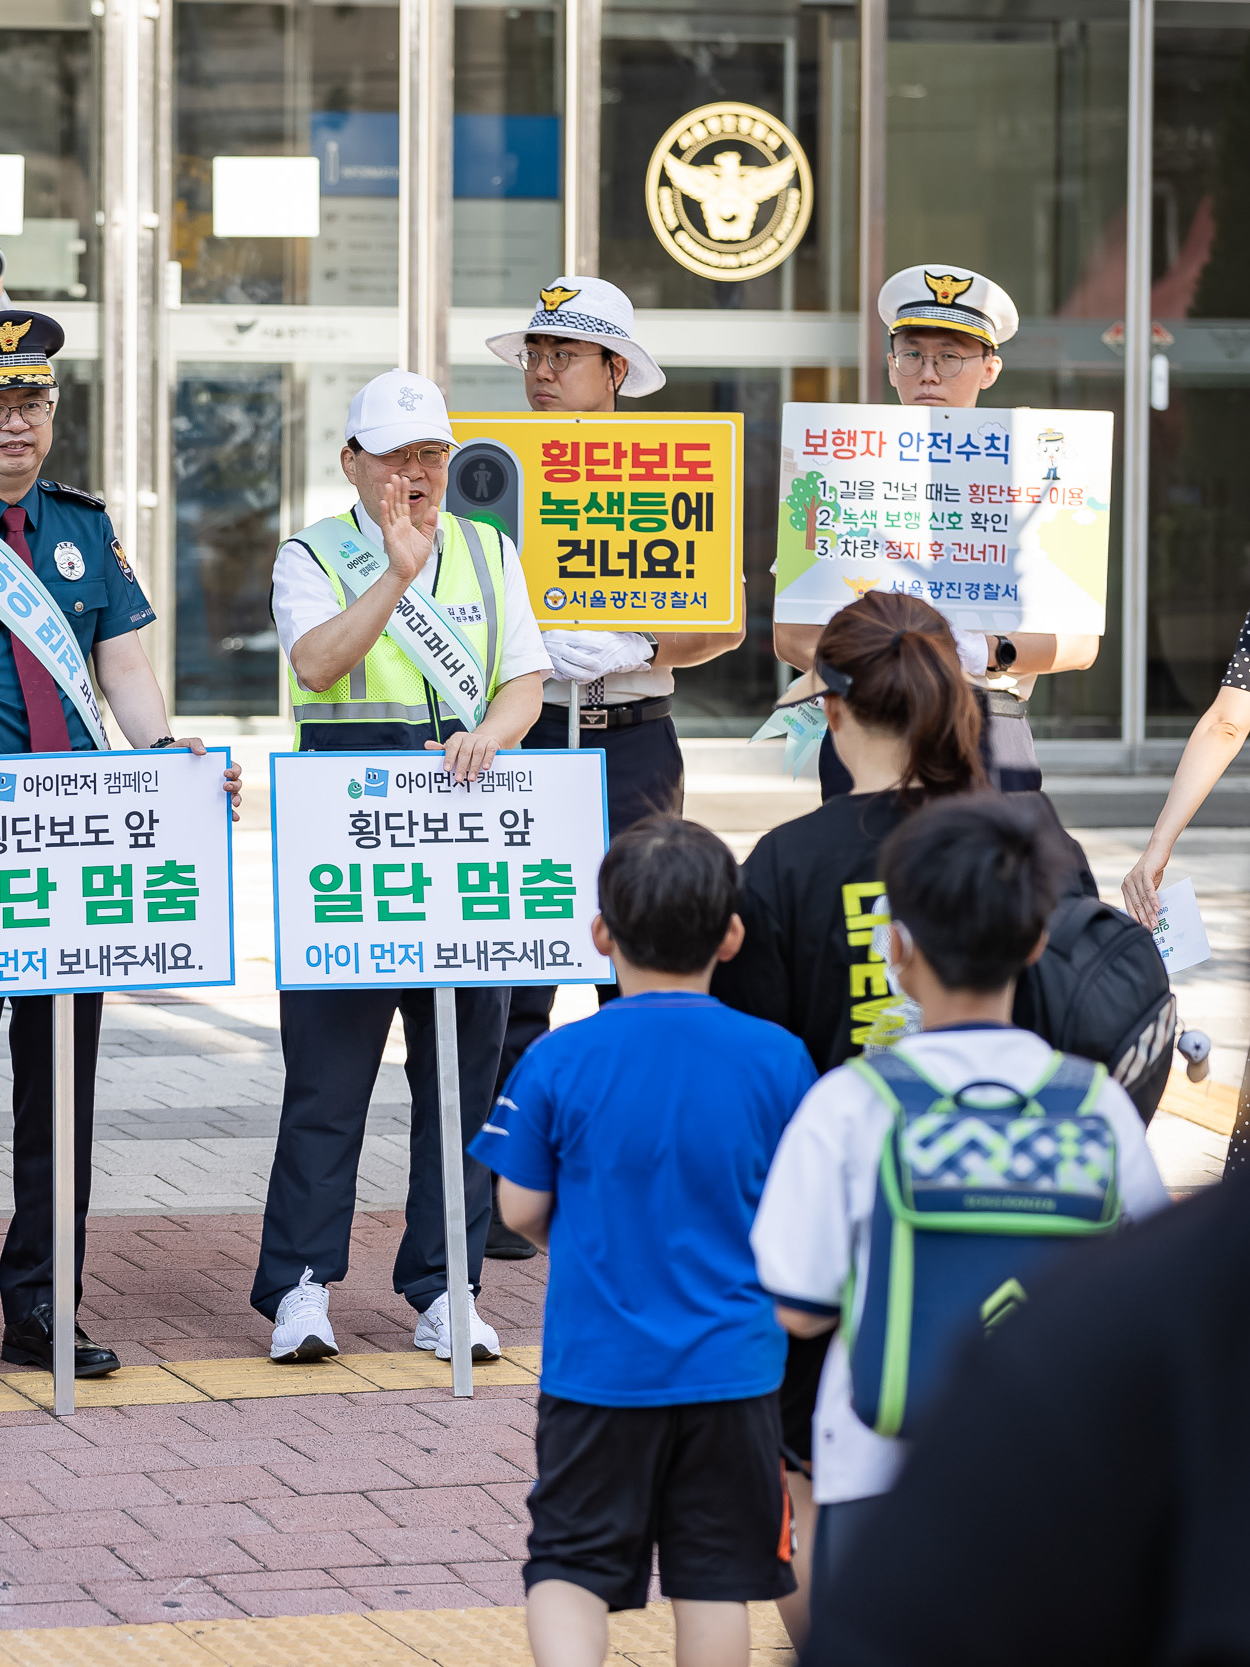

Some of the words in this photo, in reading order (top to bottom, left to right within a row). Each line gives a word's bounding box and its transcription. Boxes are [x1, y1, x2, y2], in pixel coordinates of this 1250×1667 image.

[541, 440, 714, 483] 횡단보도
[803, 428, 887, 460] 보행자
[898, 431, 1010, 464] 안전수칙
[819, 480, 833, 499] 1.
[839, 480, 875, 500] 길을
[883, 481, 918, 501] 건널
[925, 483, 961, 503] 때는
[968, 483, 1042, 505] 횡단보도
[1049, 486, 1084, 506] 이용
[540, 491, 714, 533] 녹색등에
[818, 509, 835, 528] 2.
[842, 508, 878, 529] 녹색
[884, 509, 921, 530] 보행
[928, 511, 964, 532] 신호
[970, 512, 1008, 533] 확인
[346, 551, 375, 570] 아이먼저
[358, 560, 381, 577] 캠페인
[557, 539, 695, 579] 건너요!
[816, 539, 833, 559] 3.
[840, 538, 879, 559] 차량
[885, 540, 920, 561] 정지
[928, 541, 945, 561] 후
[952, 542, 1007, 564] 건너기
[569, 590, 707, 609] 서울광진경찰서
[889, 579, 1018, 602] 서울광진경찰서
[34, 617, 82, 681] 먼저
[459, 674, 479, 701] 앞
[23, 772, 98, 798] 아이먼저
[103, 770, 159, 794] 캠페인
[476, 770, 533, 793] 캠페인
[124, 809, 160, 849] 앞
[348, 810, 489, 850] 횡단보도
[499, 808, 535, 847] 앞
[82, 859, 199, 926] 멈춤
[309, 862, 432, 924] 일단
[457, 858, 577, 921] 멈춤
[56, 942, 203, 977] 보내주세요.
[305, 942, 360, 975] 아이
[370, 941, 424, 974] 먼저
[433, 938, 582, 972] 보내주세요.
